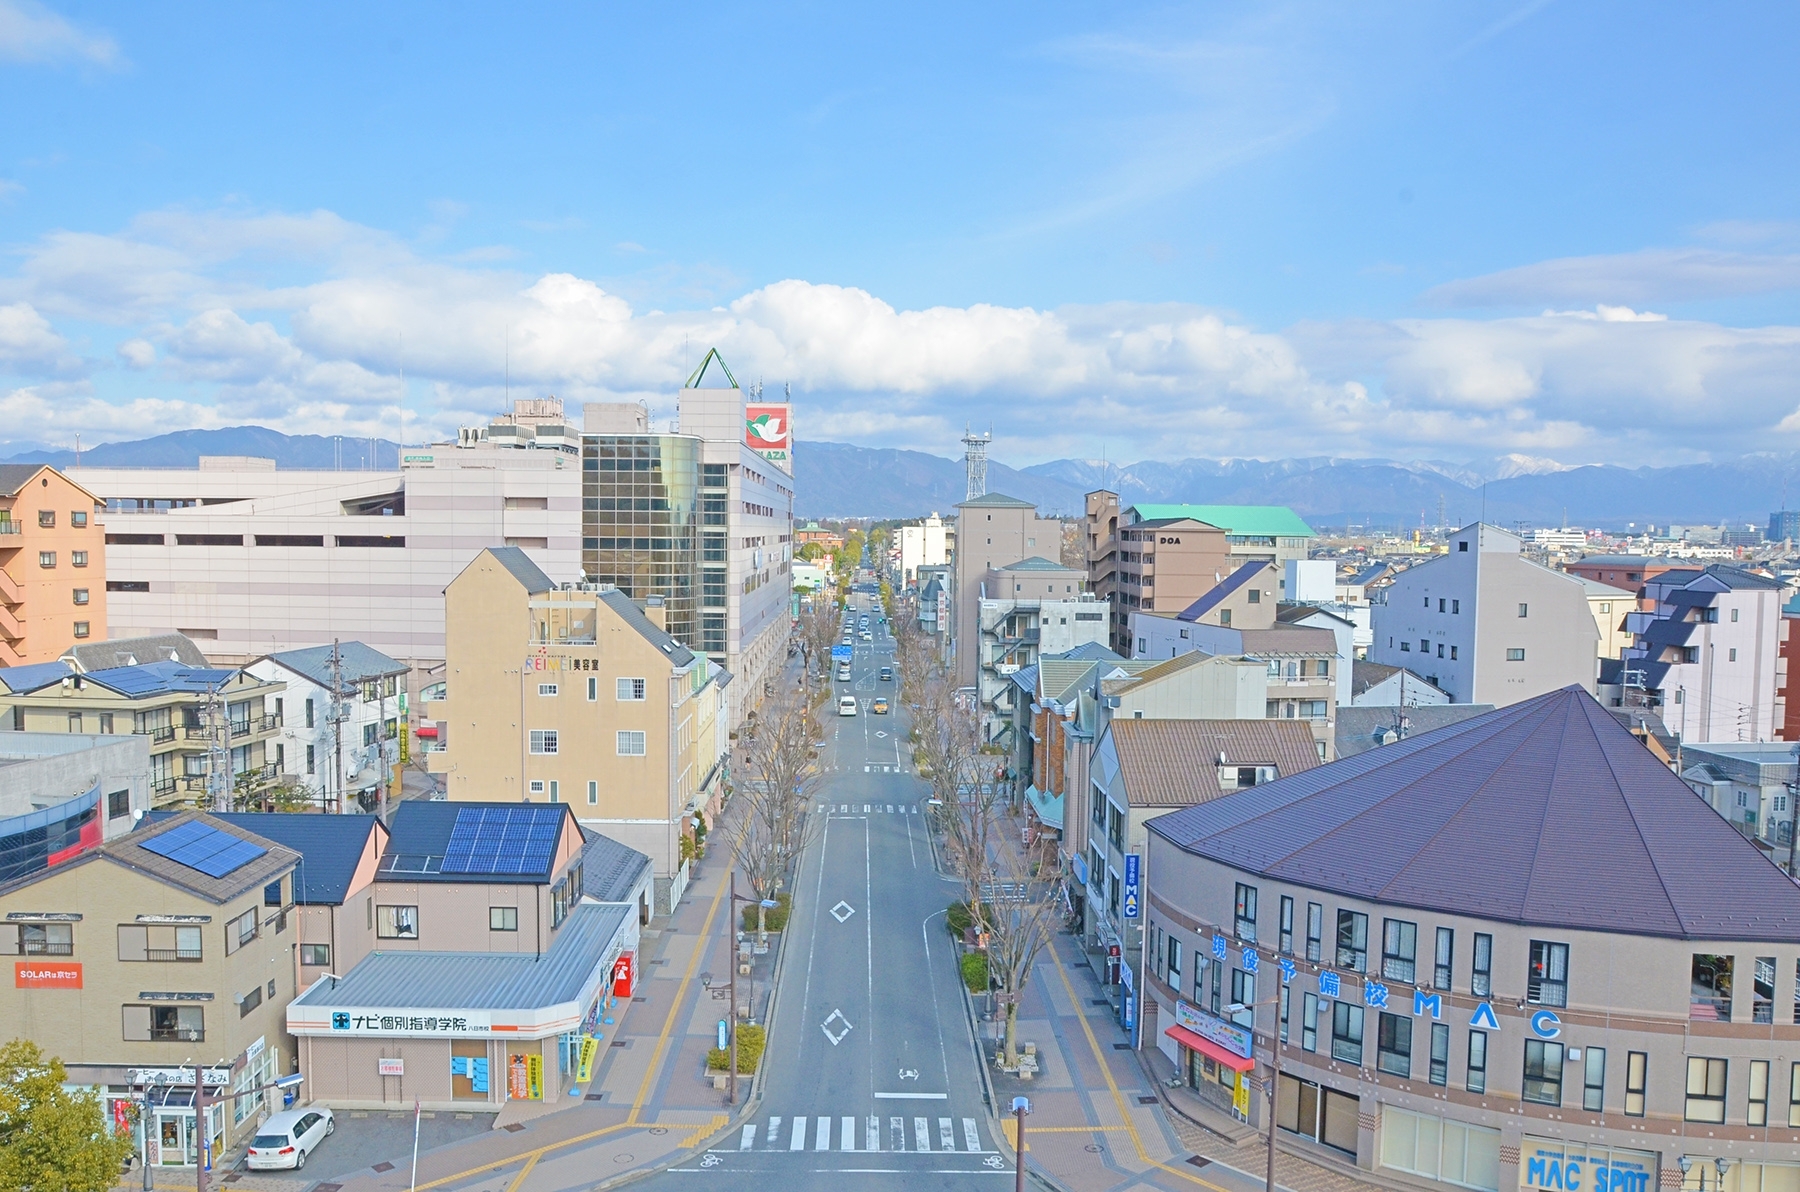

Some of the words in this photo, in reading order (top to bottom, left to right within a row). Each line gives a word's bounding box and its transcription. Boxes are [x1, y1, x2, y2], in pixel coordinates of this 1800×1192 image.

[573, 659, 599, 671] 美容室
[1126, 885, 1137, 916] MAC
[1211, 934, 1389, 1009] 現役予備校
[1413, 990, 1561, 1039] MAC
[352, 1013, 467, 1031] ナビ個別指導学院
[1527, 1157, 1580, 1191] MAC
[1595, 1167, 1649, 1192] SPOT
